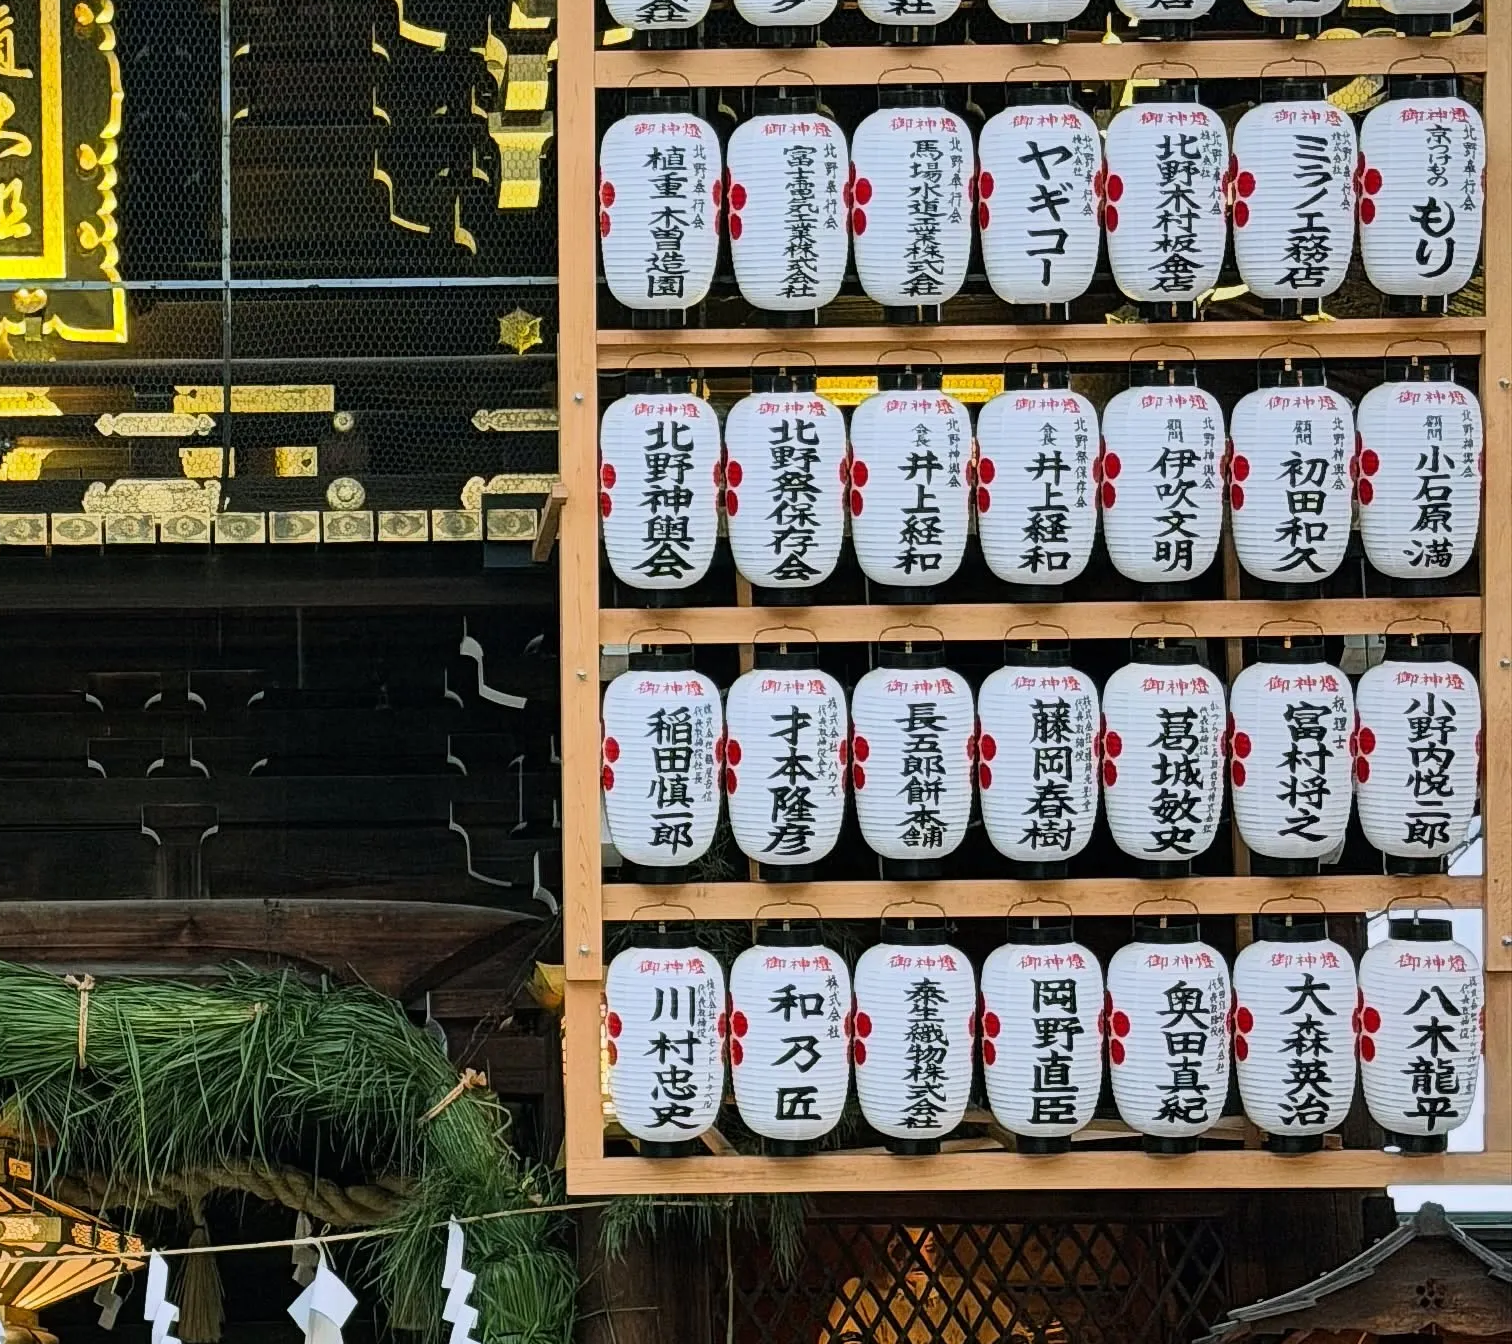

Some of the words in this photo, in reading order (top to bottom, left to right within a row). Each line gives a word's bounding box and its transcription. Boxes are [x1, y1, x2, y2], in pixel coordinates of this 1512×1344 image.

[1019, 141, 1073, 286] ヤギコー
[1149, 134, 1204, 292] 北野木村板金店
[1275, 135, 1332, 289] ミラノ工務店
[1410, 197, 1455, 278] もり
[767, 419, 821, 580] 北野祭保存会
[894, 451, 944, 574] 井上経和
[1018, 451, 1071, 573] 井上経和
[1151, 448, 1201, 572] 伊吹文明
[1272, 451, 1329, 573] 初田和久
[1404, 446, 1455, 567] 小石原満
[647, 707, 694, 855] 稲田慎一郎
[761, 706, 818, 855] 才本隆彦
[1018, 698, 1077, 851] 藤岡春樹
[1143, 707, 1203, 854] 葛城敏史
[1402, 693, 1457, 849] 小野内悦二郎
[646, 987, 701, 1129] 川村忠史
[771, 984, 824, 1120] 和乃匠
[1027, 979, 1084, 1124] 岡野直臣
[1152, 981, 1210, 1124] 奥田真紀
[1279, 973, 1336, 1125] 大森英治
[1402, 986, 1462, 1131] 八木龍平
